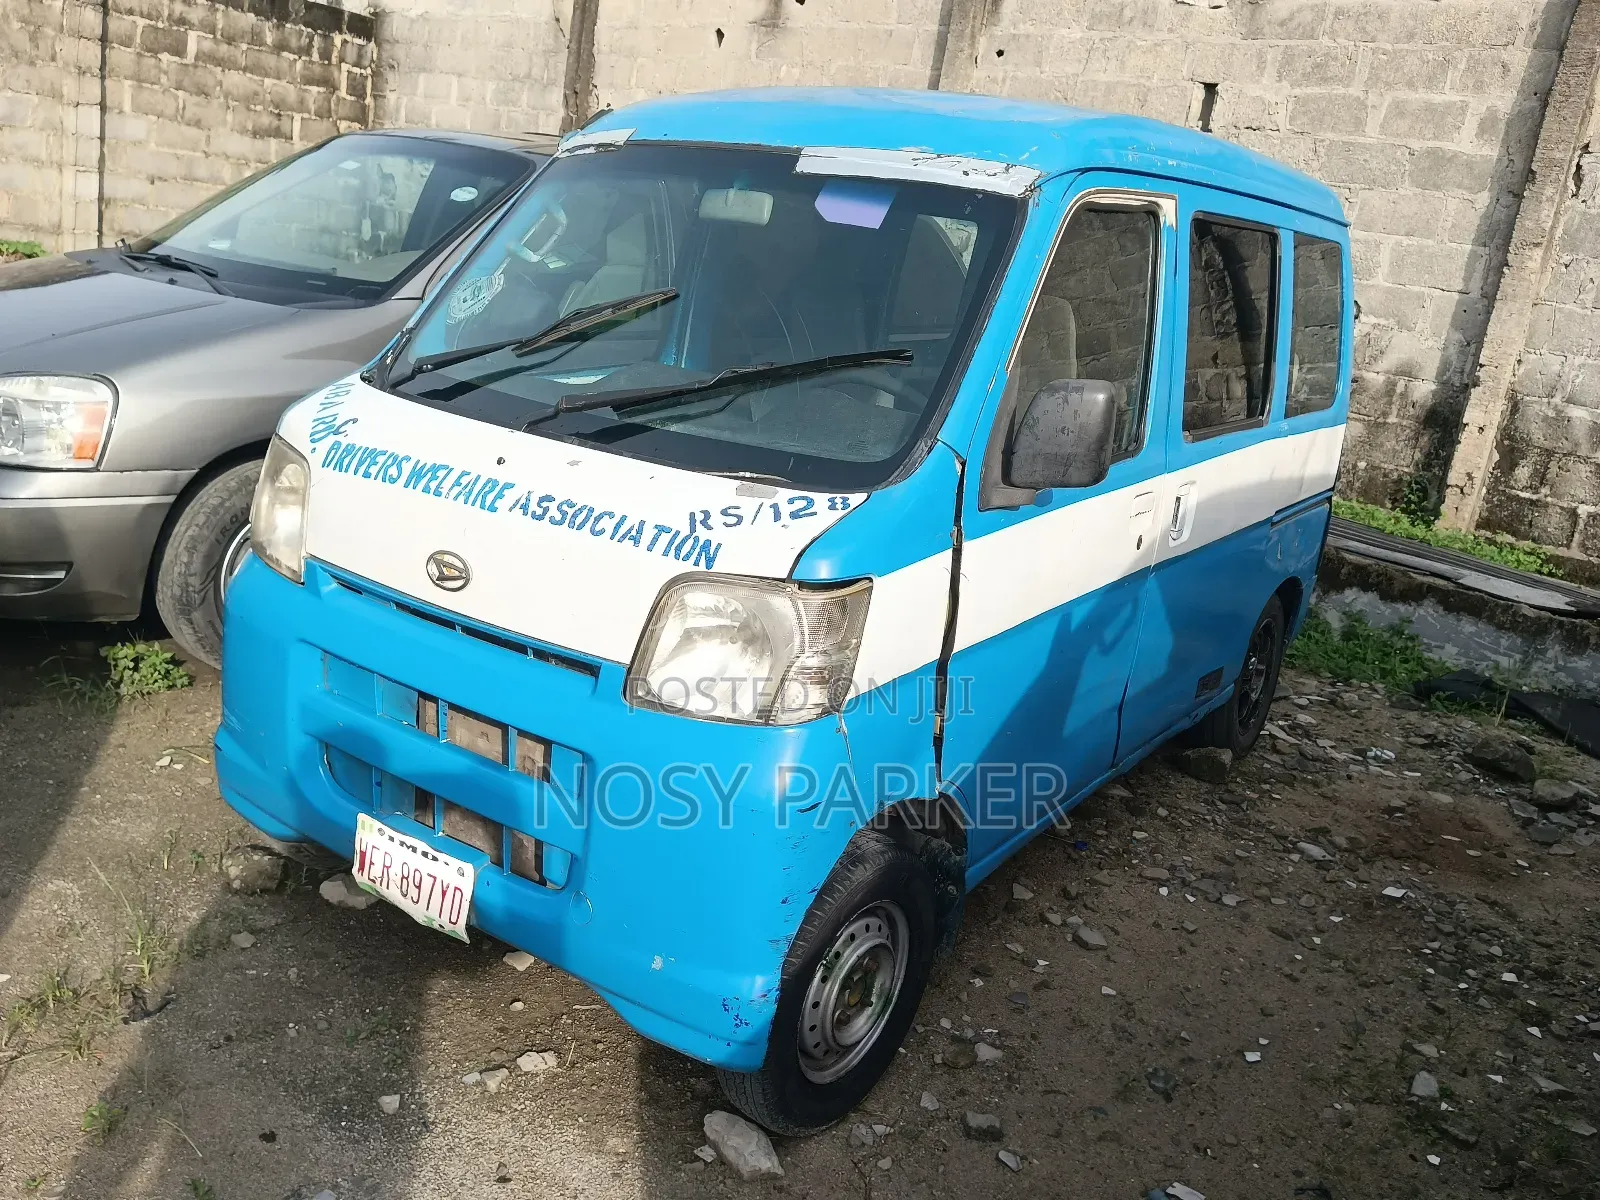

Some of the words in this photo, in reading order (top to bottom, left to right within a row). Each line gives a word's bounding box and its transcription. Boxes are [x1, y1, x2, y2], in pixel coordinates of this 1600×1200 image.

[321, 440, 411, 485] DRIVERS
[403, 457, 516, 513] WELFARE
[508, 490, 722, 570] ASSOCIATION
